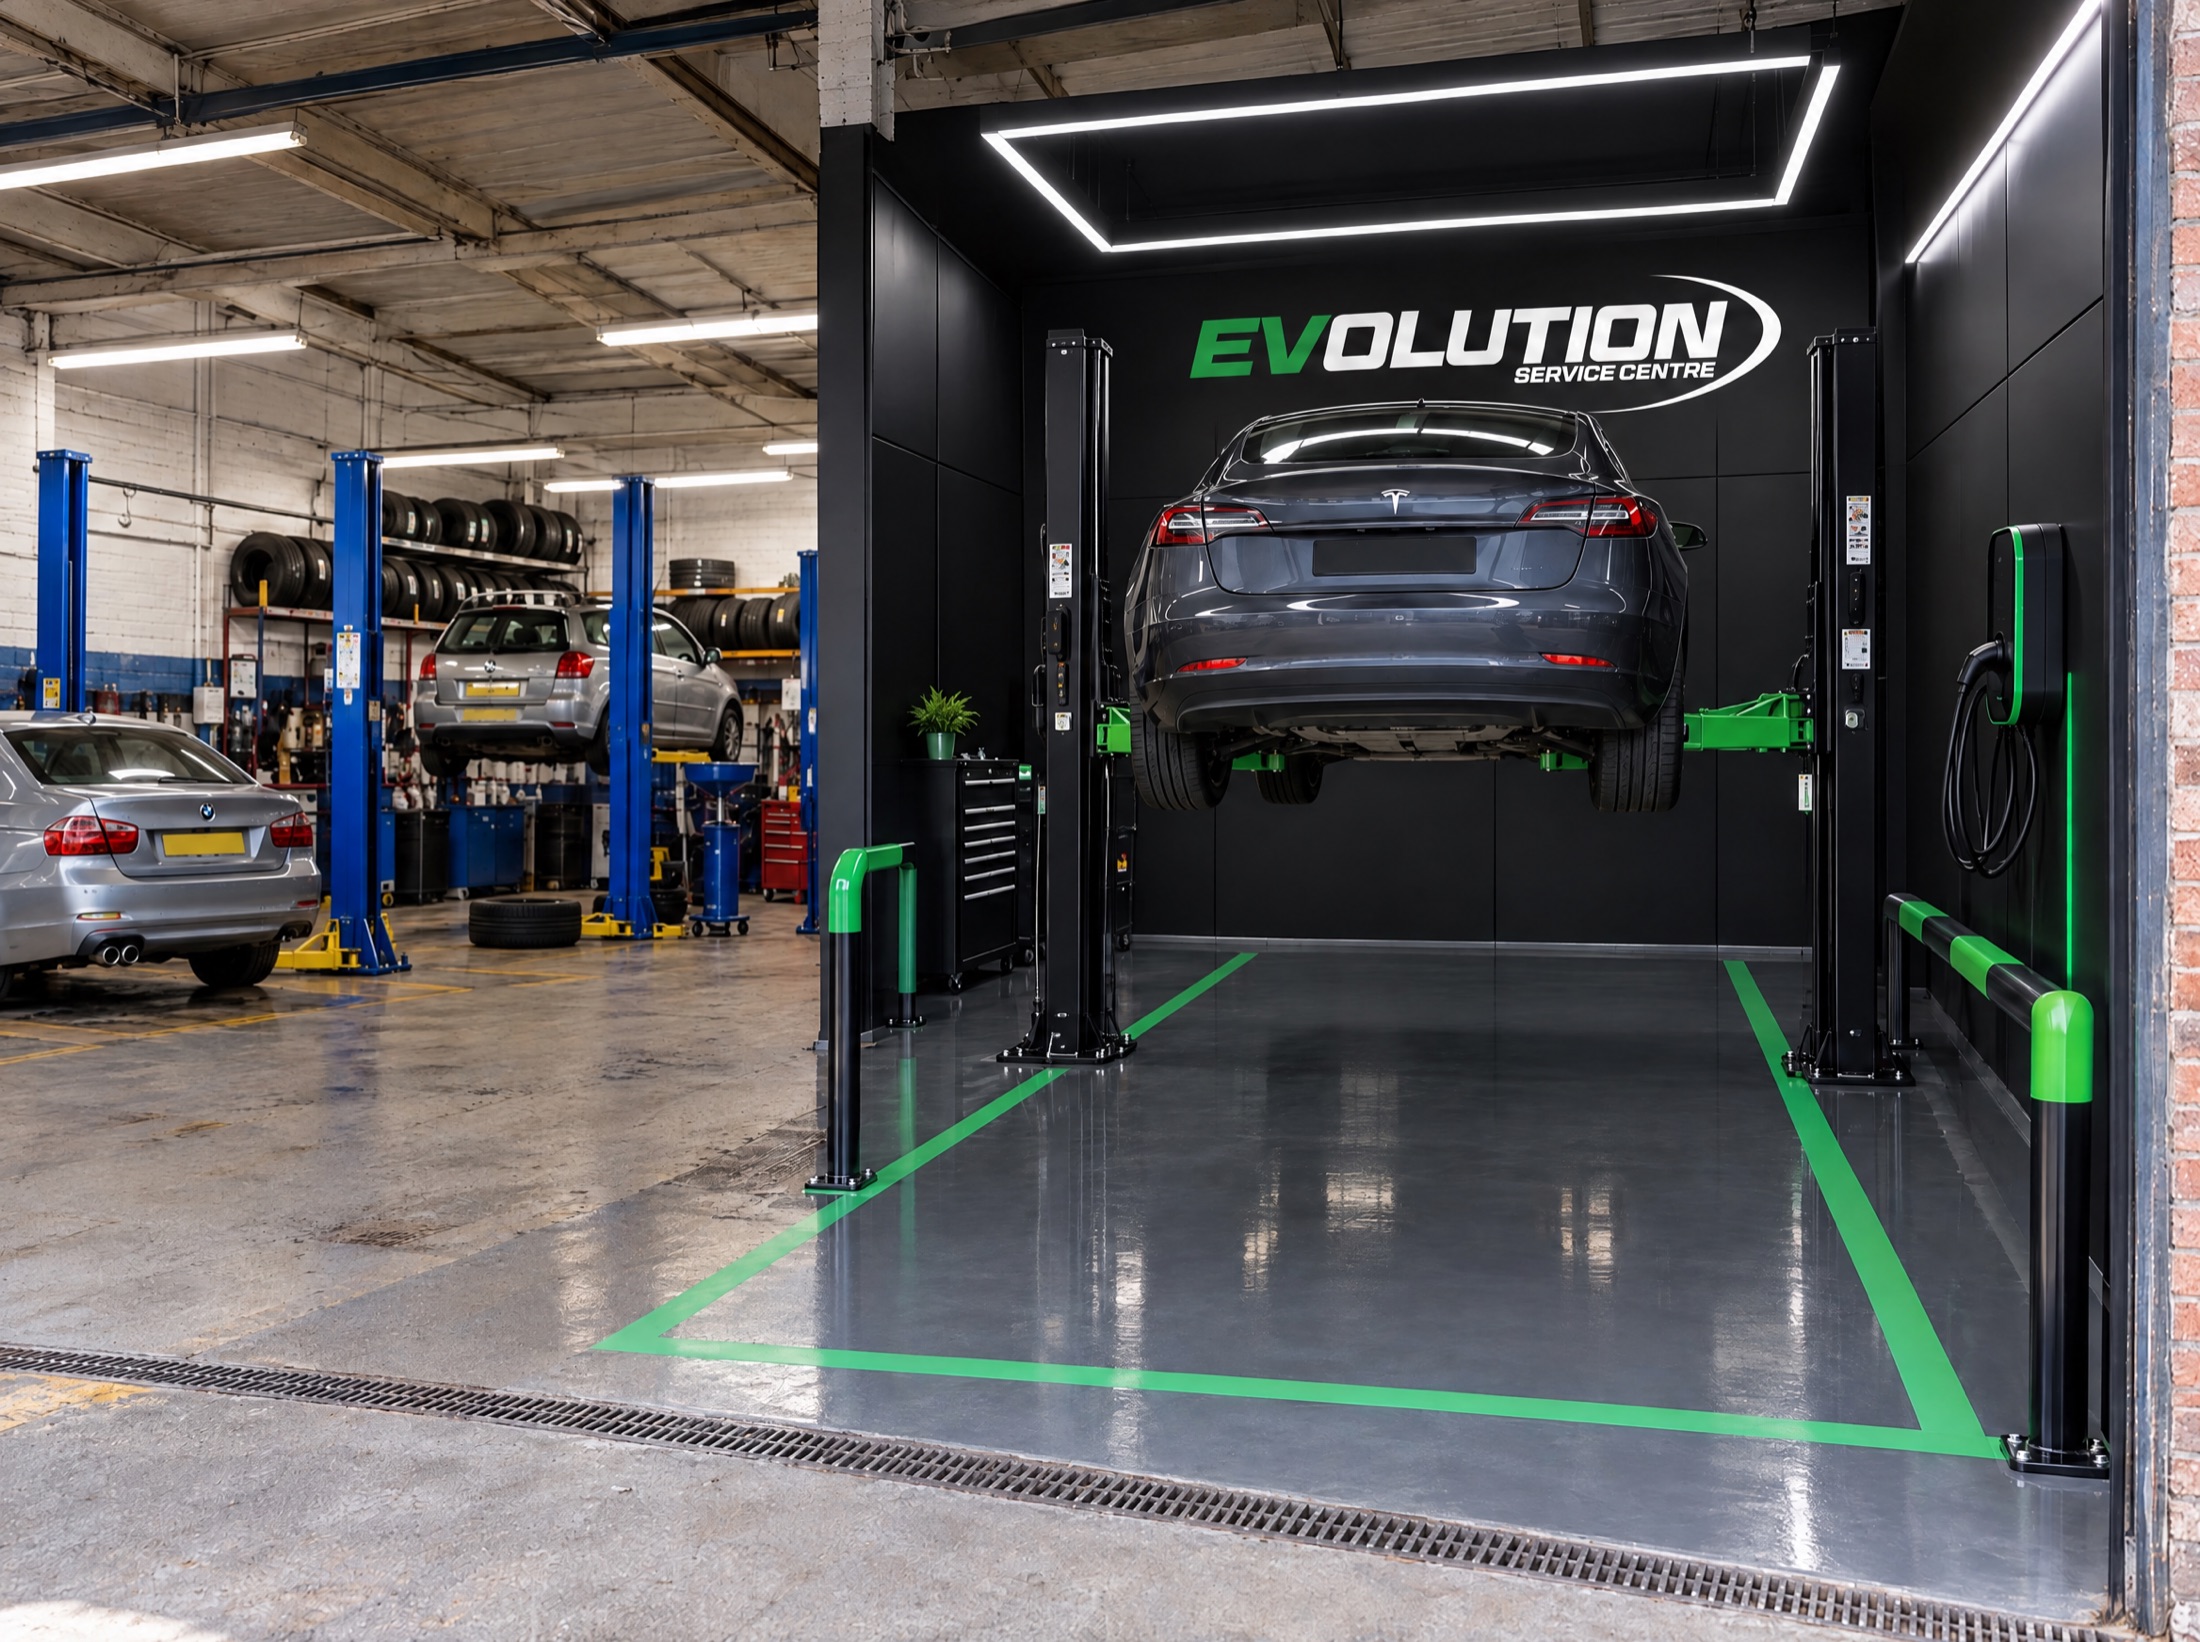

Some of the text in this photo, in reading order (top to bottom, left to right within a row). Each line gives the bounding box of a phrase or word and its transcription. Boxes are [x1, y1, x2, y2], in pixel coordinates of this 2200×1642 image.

[1190, 300, 1728, 378] EVOLUTION
[1514, 361, 1716, 384] SERVICE CENTRE
